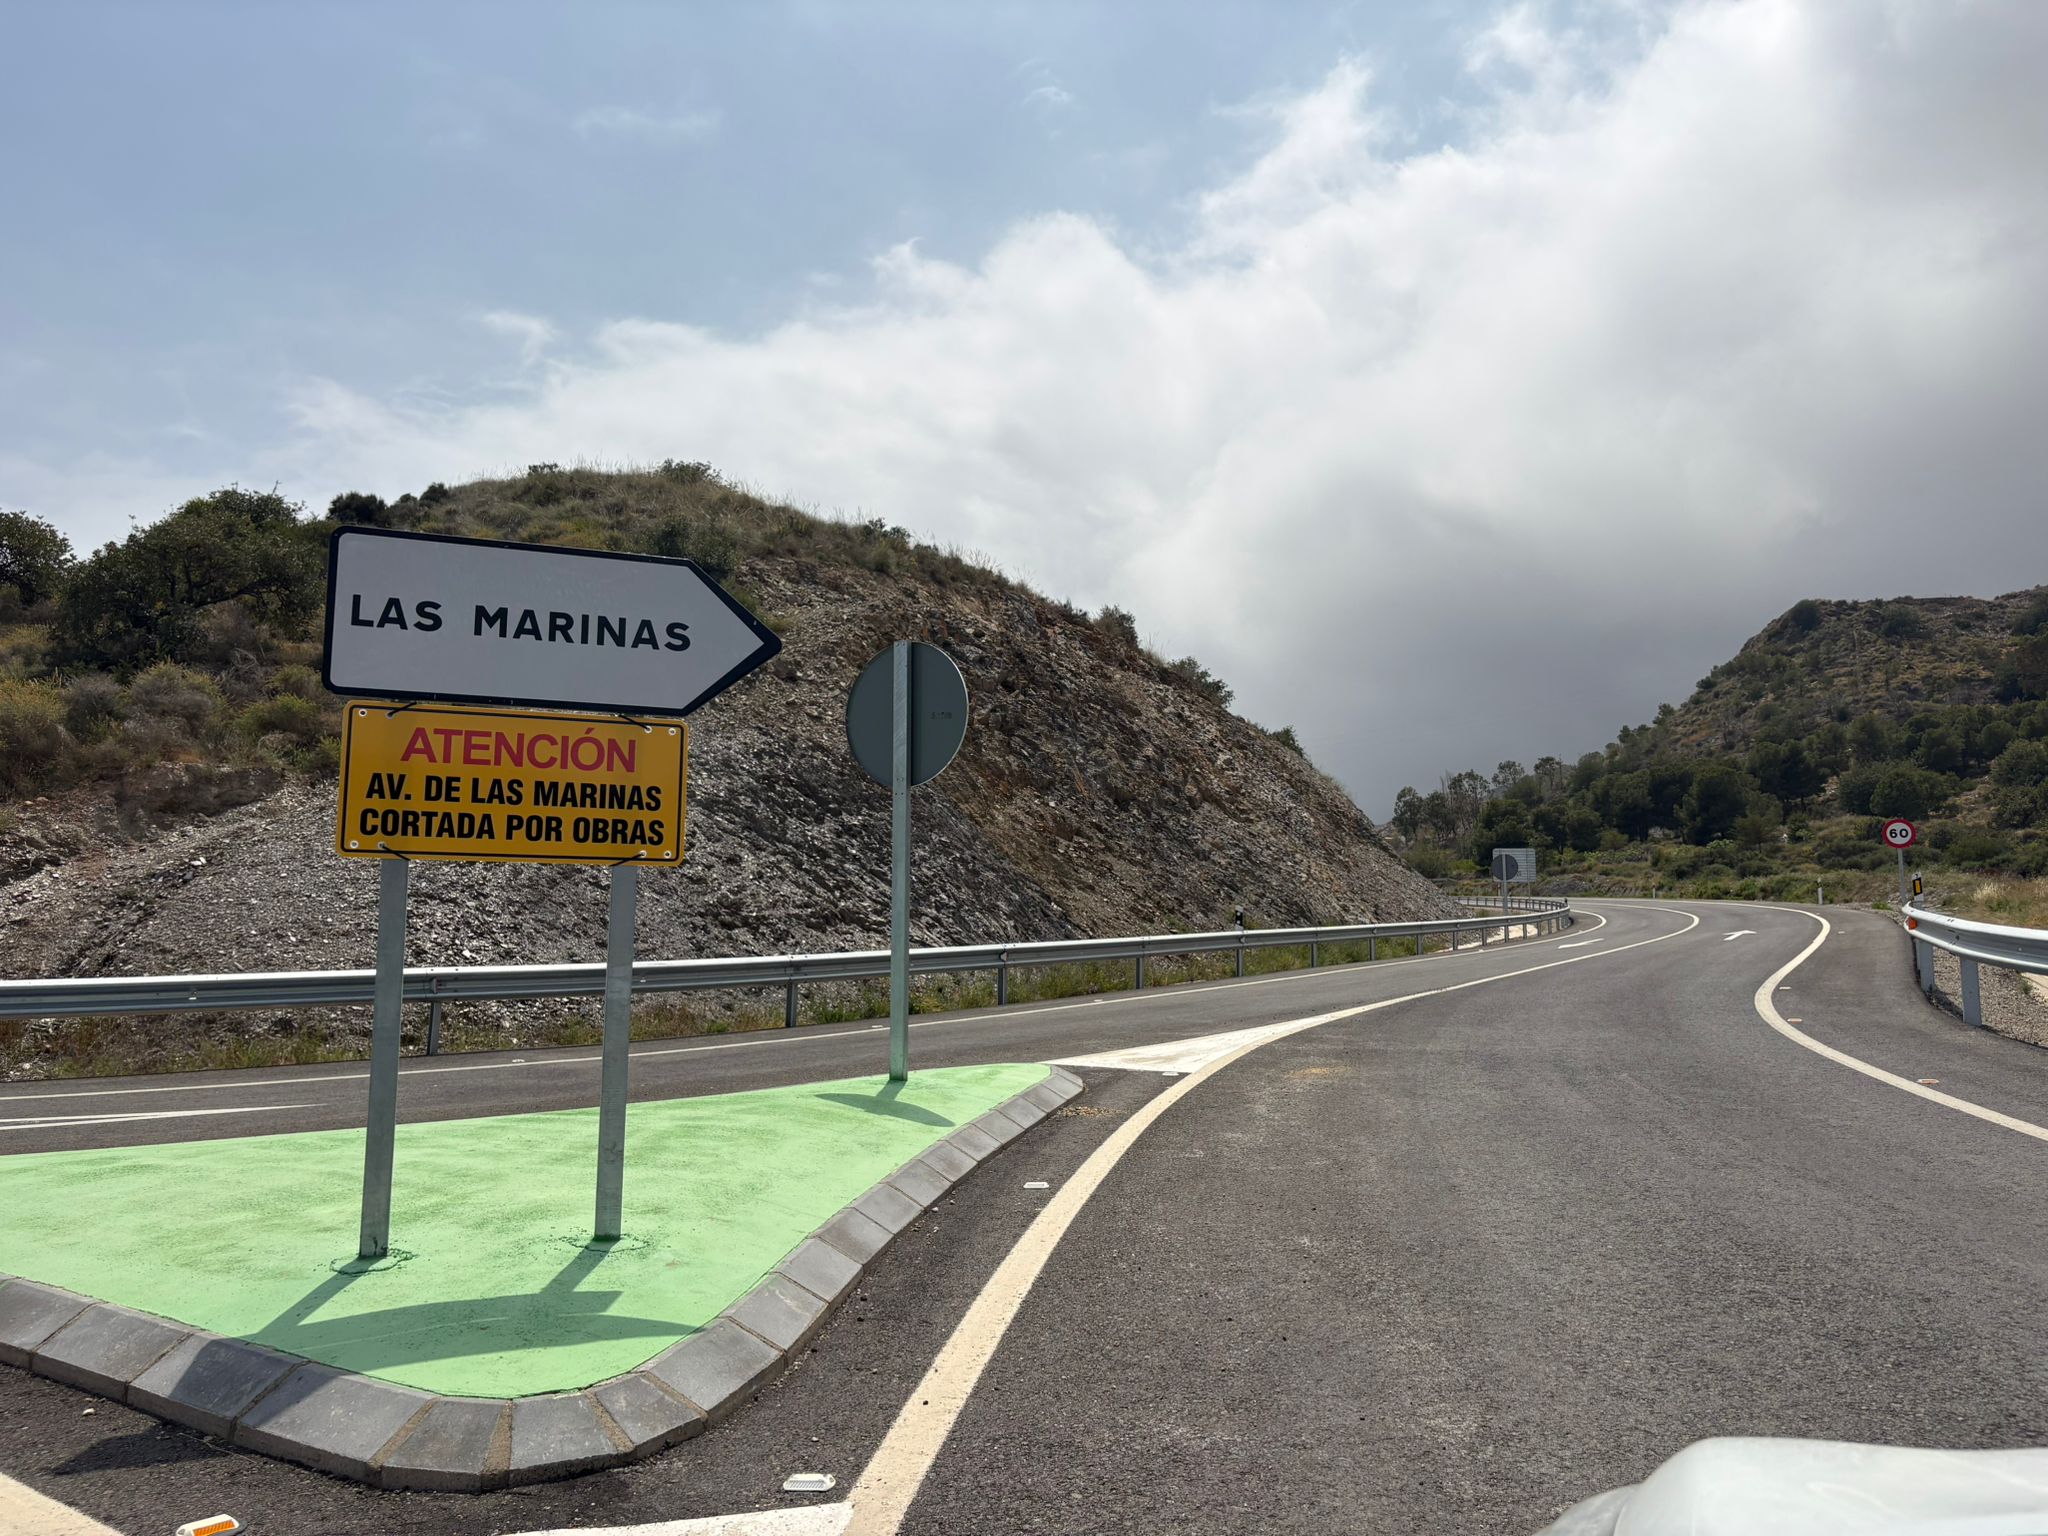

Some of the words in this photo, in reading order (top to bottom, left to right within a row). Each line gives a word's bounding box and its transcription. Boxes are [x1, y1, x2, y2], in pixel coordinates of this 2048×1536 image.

[350, 594, 443, 632] LAS
[473, 605, 691, 651] MARINAS
[400, 727, 637, 773] ATENCIÓN
[365, 772, 412, 802] AV.
[424, 775, 461, 804] DE
[470, 778, 523, 806] LAS
[533, 781, 662, 812] MARINAS
[360, 808, 495, 840] CORTADA
[505, 813, 563, 842] POR
[573, 816, 664, 846] OBRAS
[1889, 828, 1909, 838] 60
